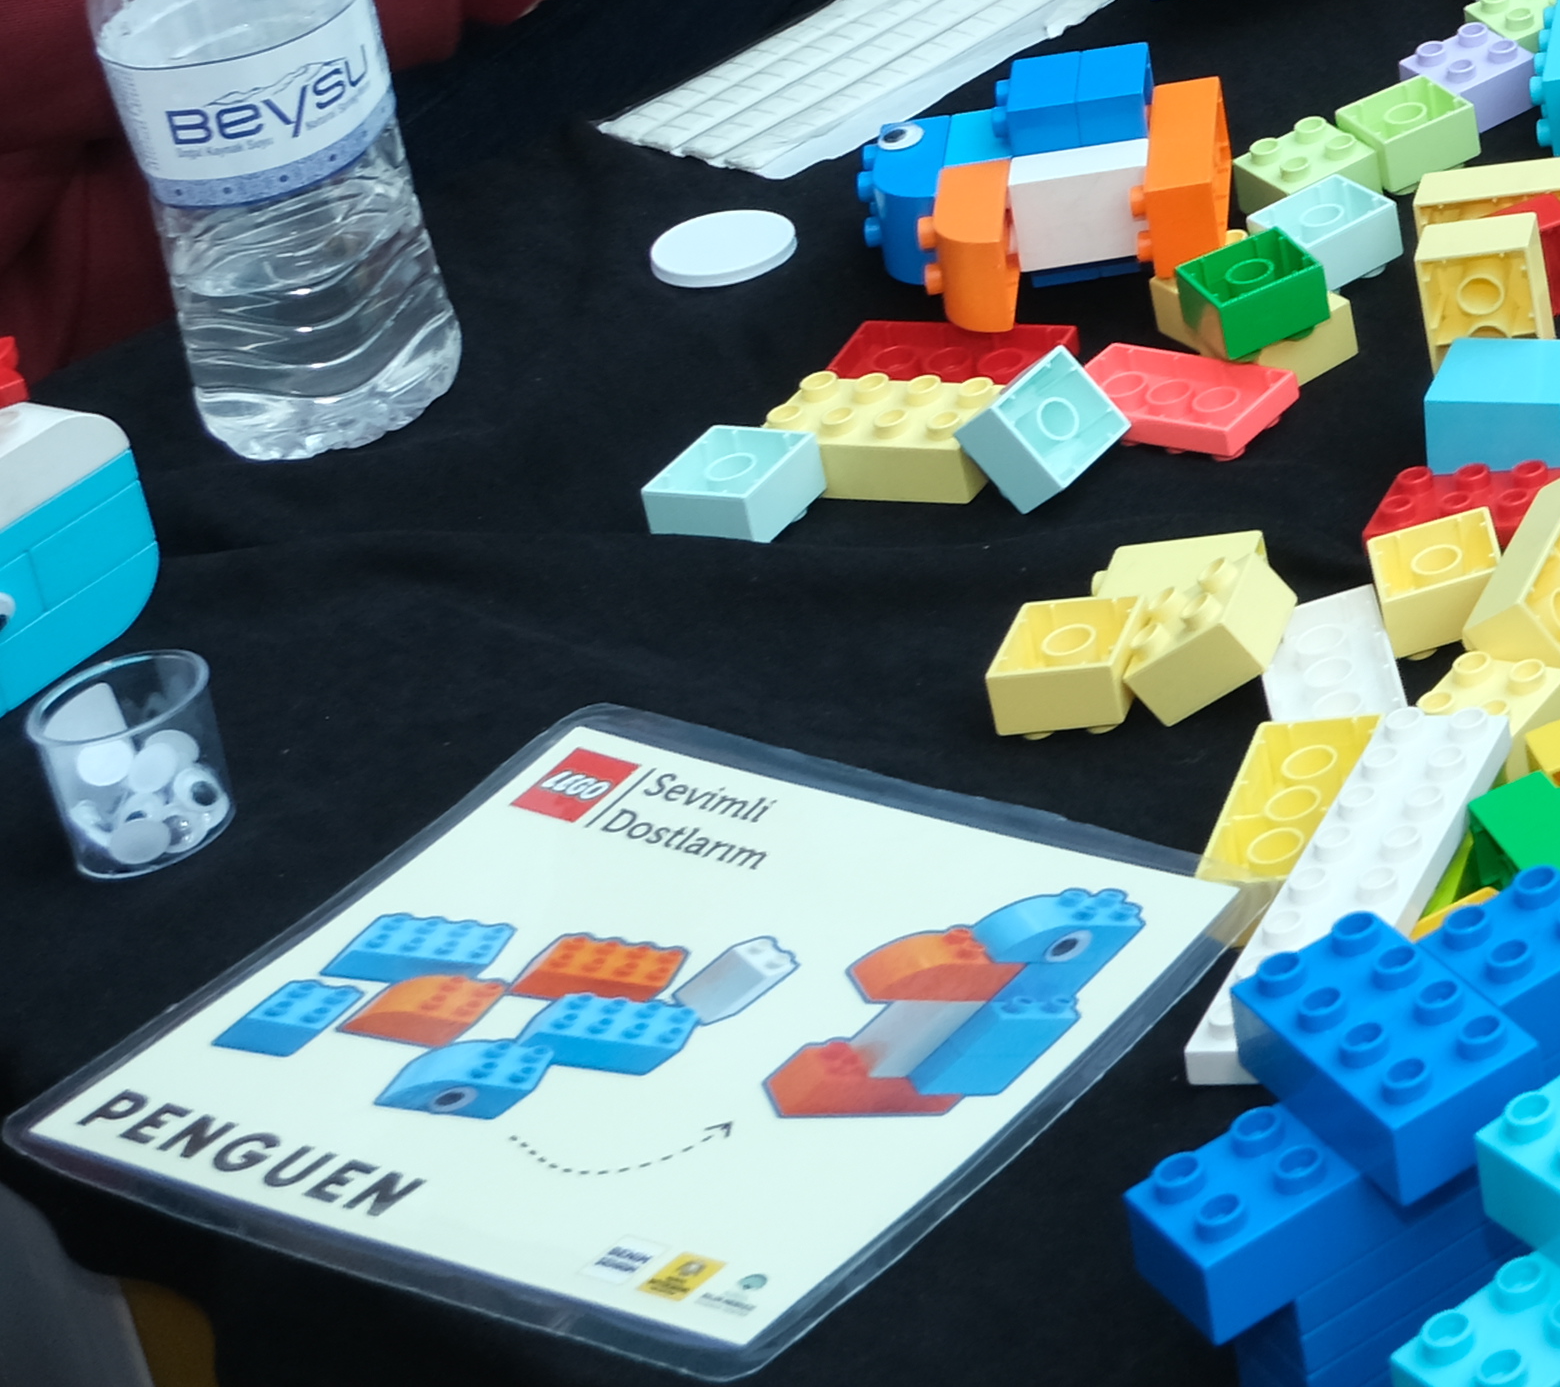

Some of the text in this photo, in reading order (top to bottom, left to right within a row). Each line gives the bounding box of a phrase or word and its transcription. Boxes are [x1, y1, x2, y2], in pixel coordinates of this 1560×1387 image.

[539, 769, 612, 802] LEGO
[643, 771, 778, 823] Sevimli
[600, 807, 768, 870] Dostlarım
[76, 1088, 428, 1217] PENGUEN
